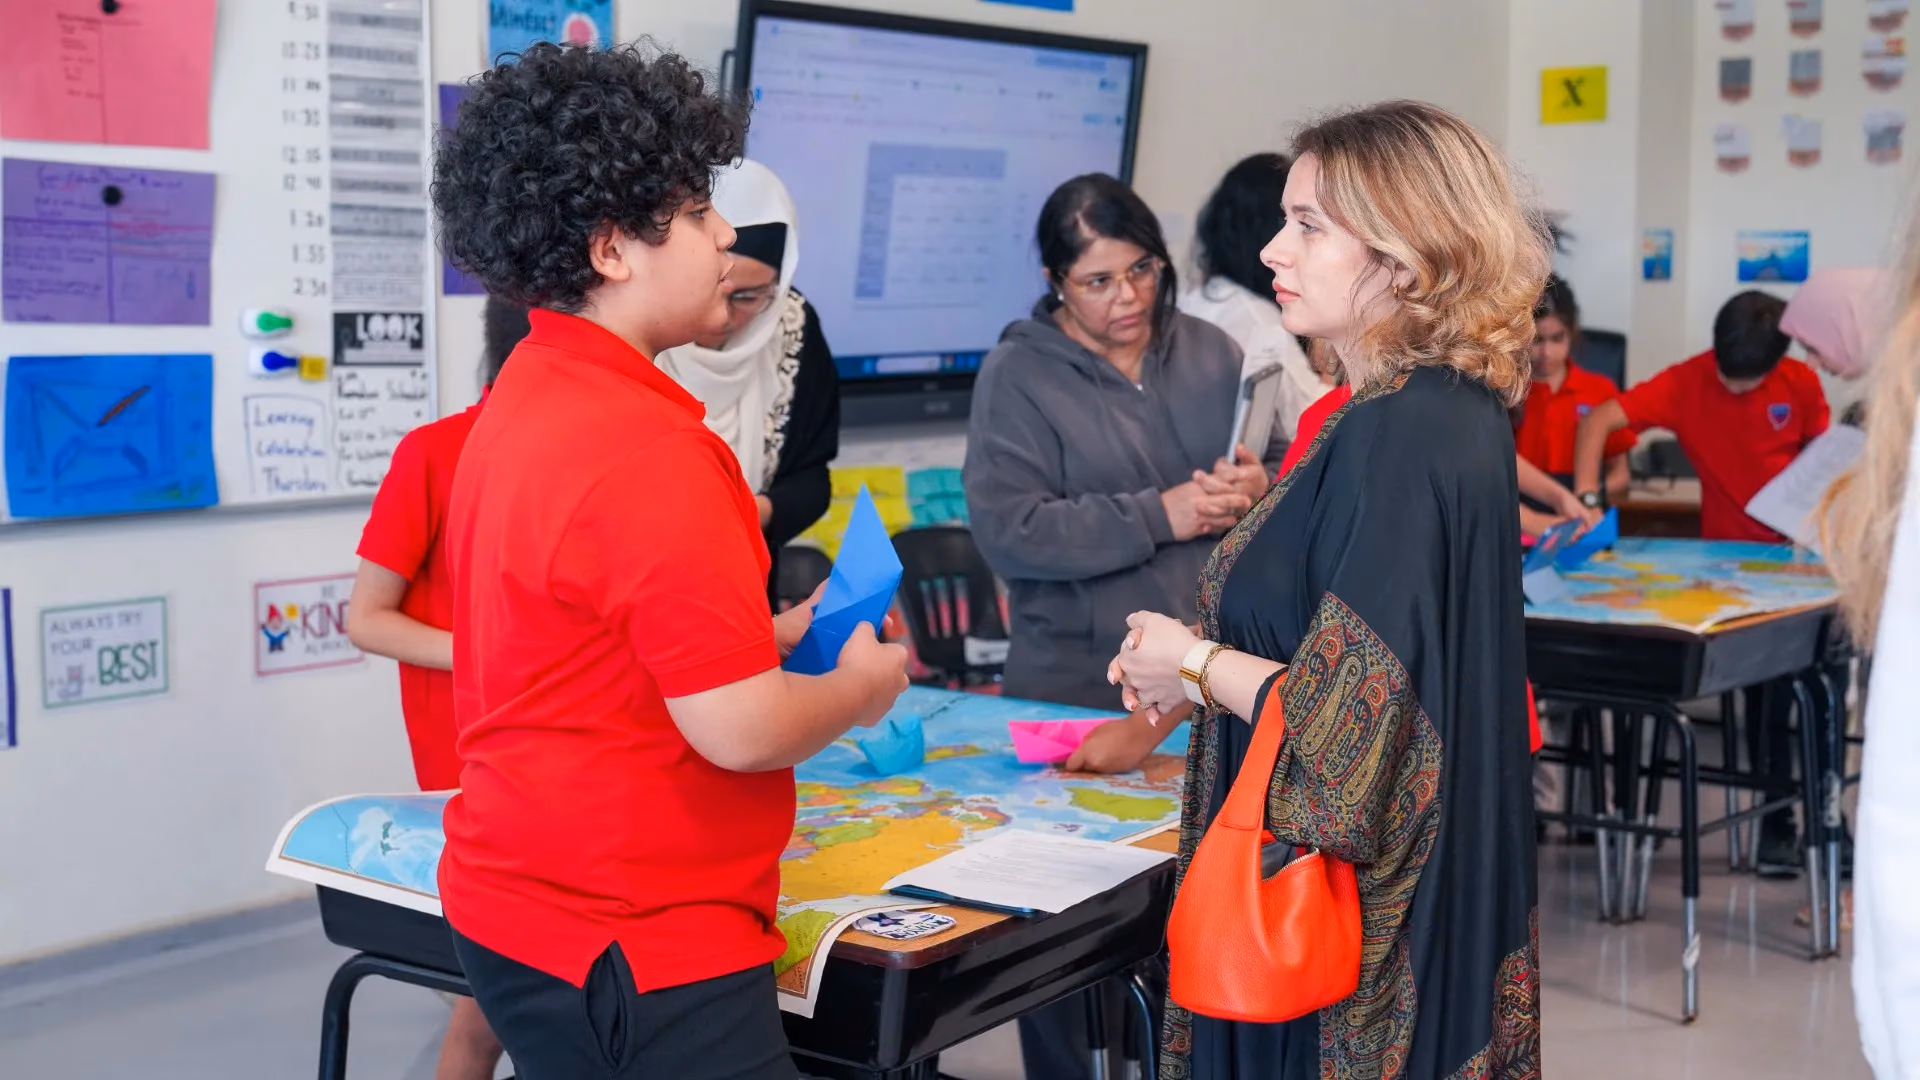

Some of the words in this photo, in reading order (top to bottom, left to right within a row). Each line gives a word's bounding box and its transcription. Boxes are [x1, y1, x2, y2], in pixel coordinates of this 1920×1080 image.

[355, 312, 421, 342] LOOK
[254, 403, 314, 440] Learning
[50, 611, 114, 634] ALWAYS
[117, 608, 142, 627] TRY
[98, 639, 158, 686] BEST
